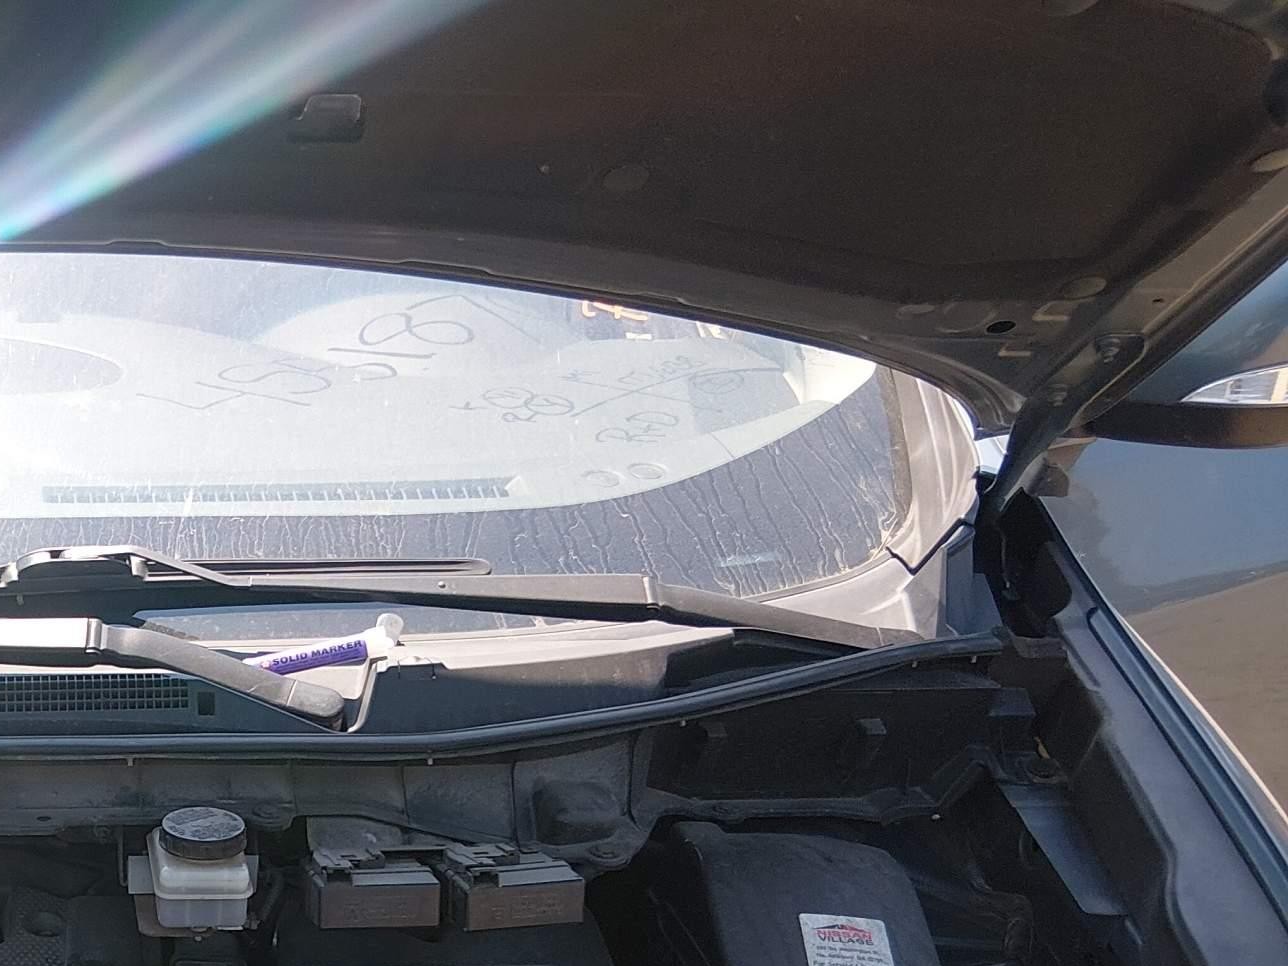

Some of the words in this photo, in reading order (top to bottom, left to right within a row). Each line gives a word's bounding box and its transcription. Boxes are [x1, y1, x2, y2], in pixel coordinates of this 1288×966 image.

[272, 651, 308, 667] SOLID
[312, 640, 363, 657] MARKER
[815, 930, 873, 941] NISSAN
[816, 933, 874, 946] VILLAGE
